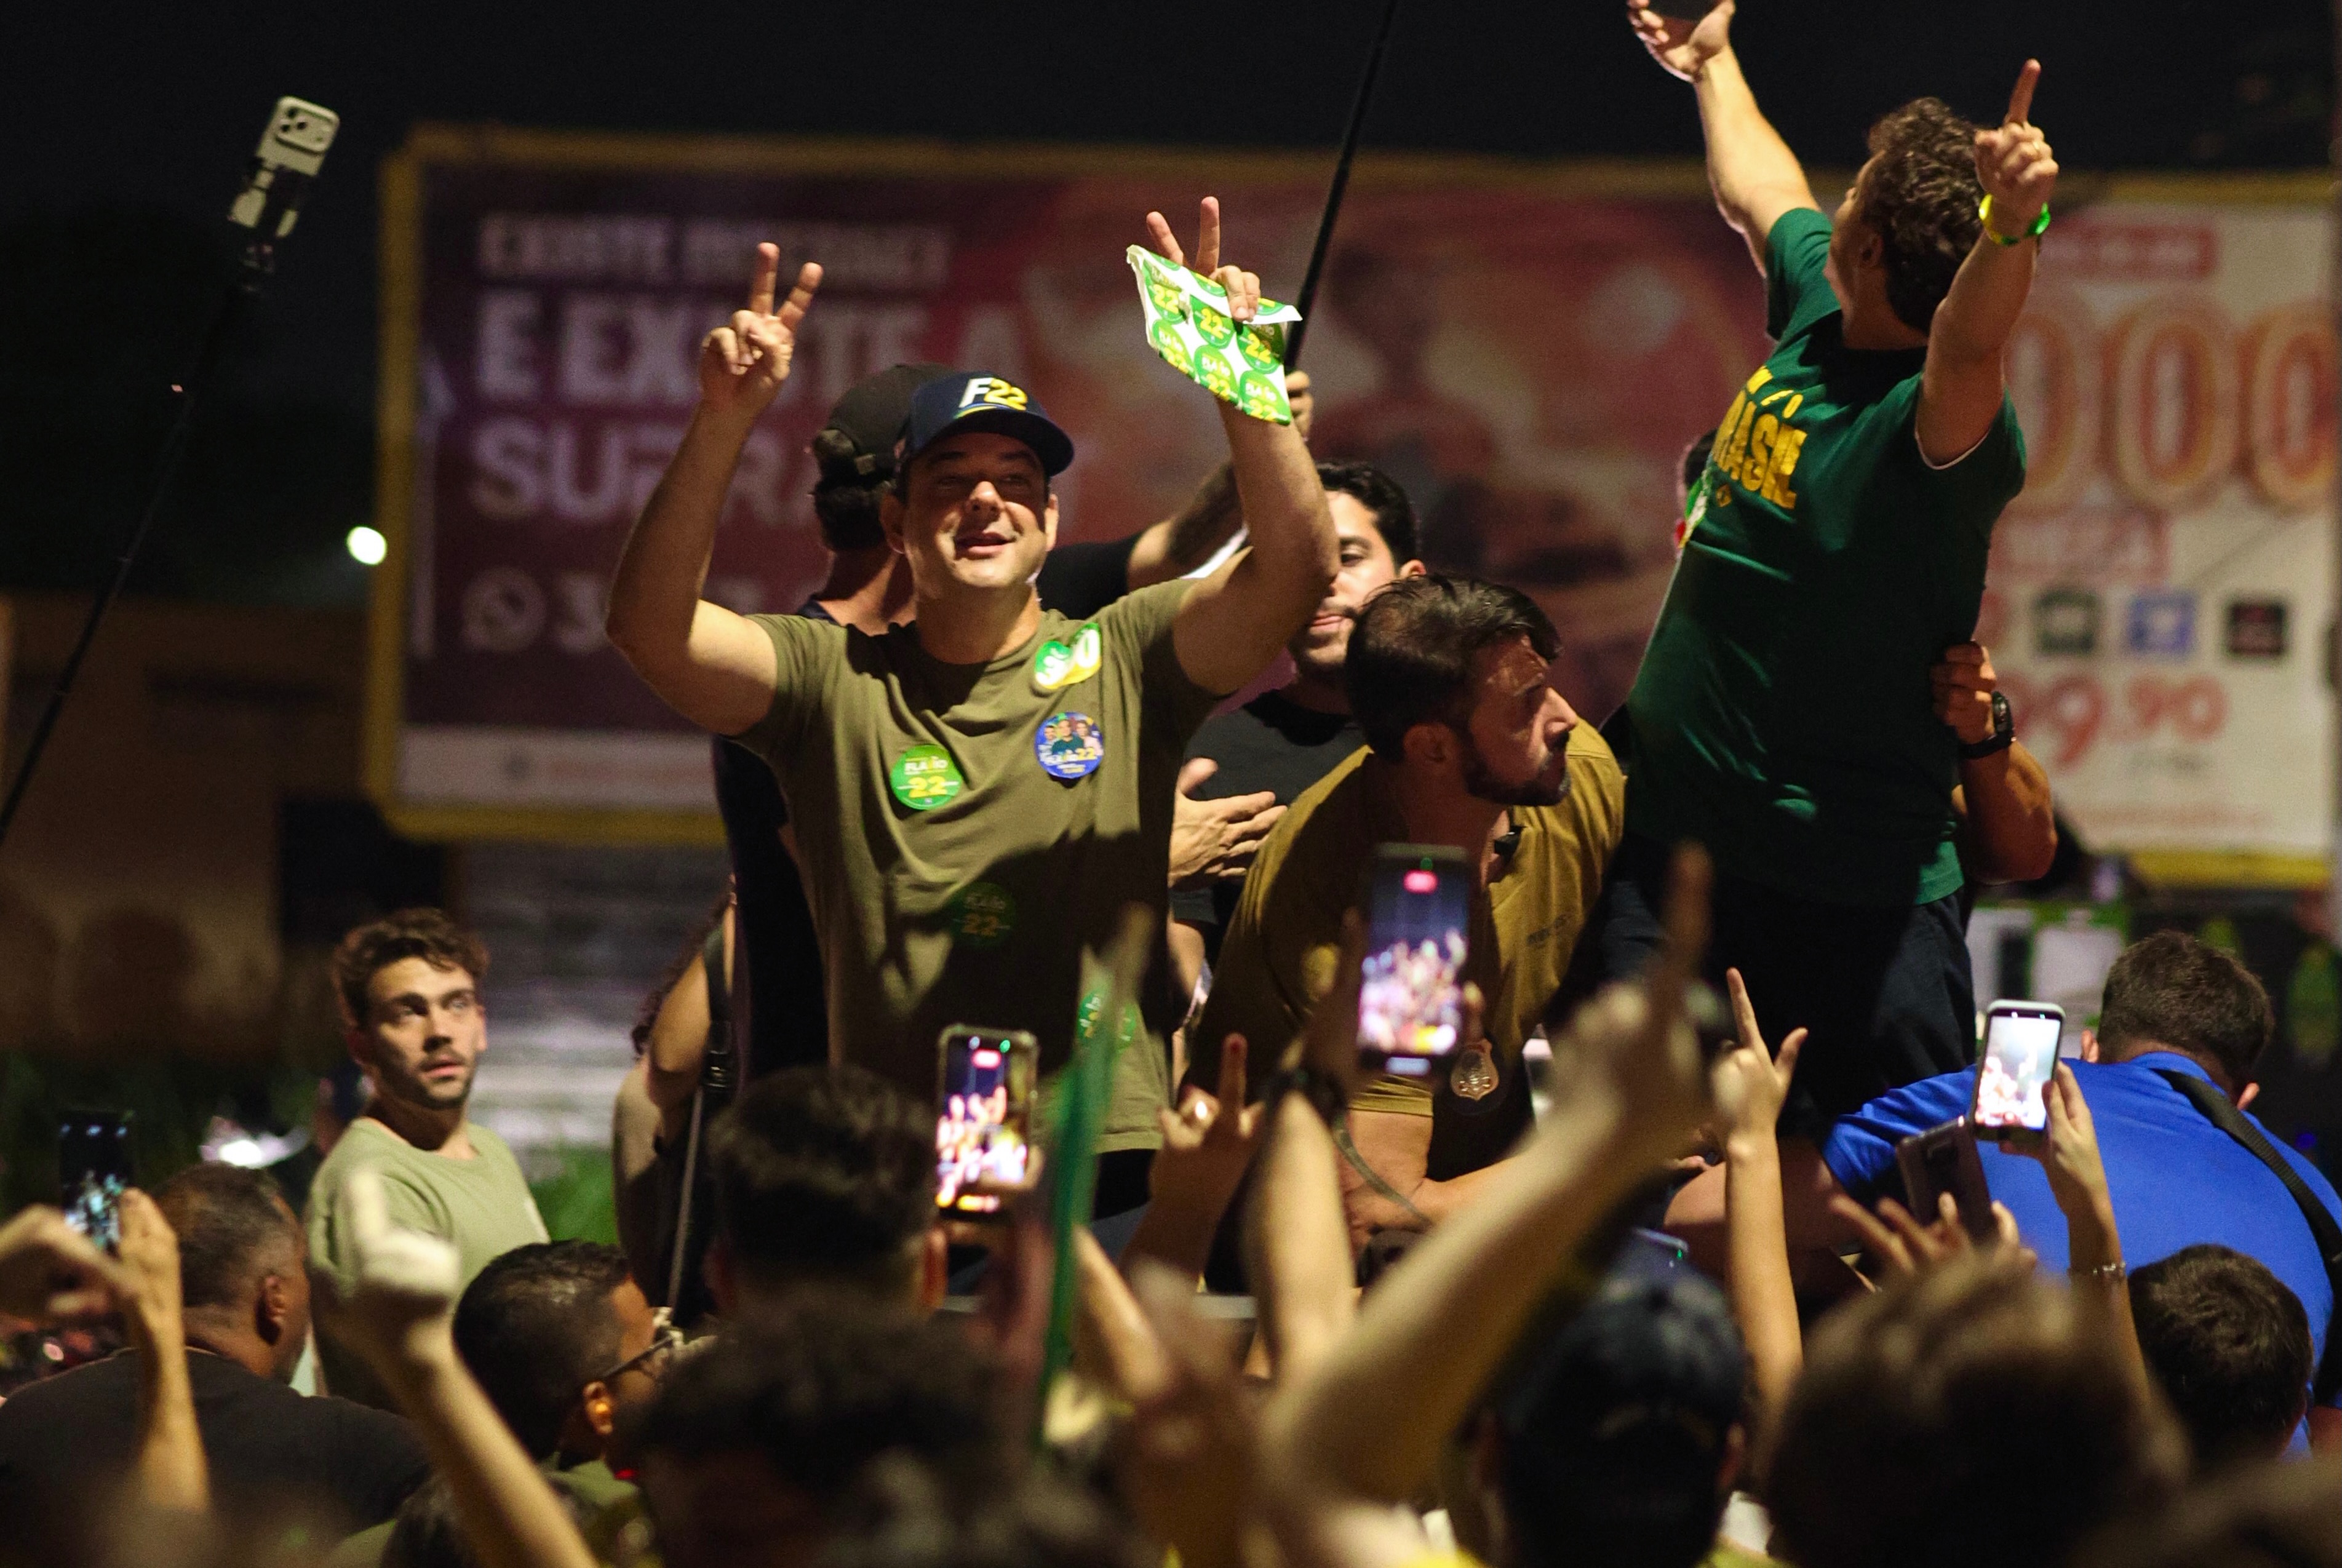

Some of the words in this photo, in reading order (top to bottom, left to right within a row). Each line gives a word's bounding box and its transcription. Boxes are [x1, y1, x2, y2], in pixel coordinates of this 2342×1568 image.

[1200, 308, 1224, 340] 22
[560, 295, 928, 406] EXTE
[958, 377, 1028, 411] F22
[909, 776, 947, 798] 22
